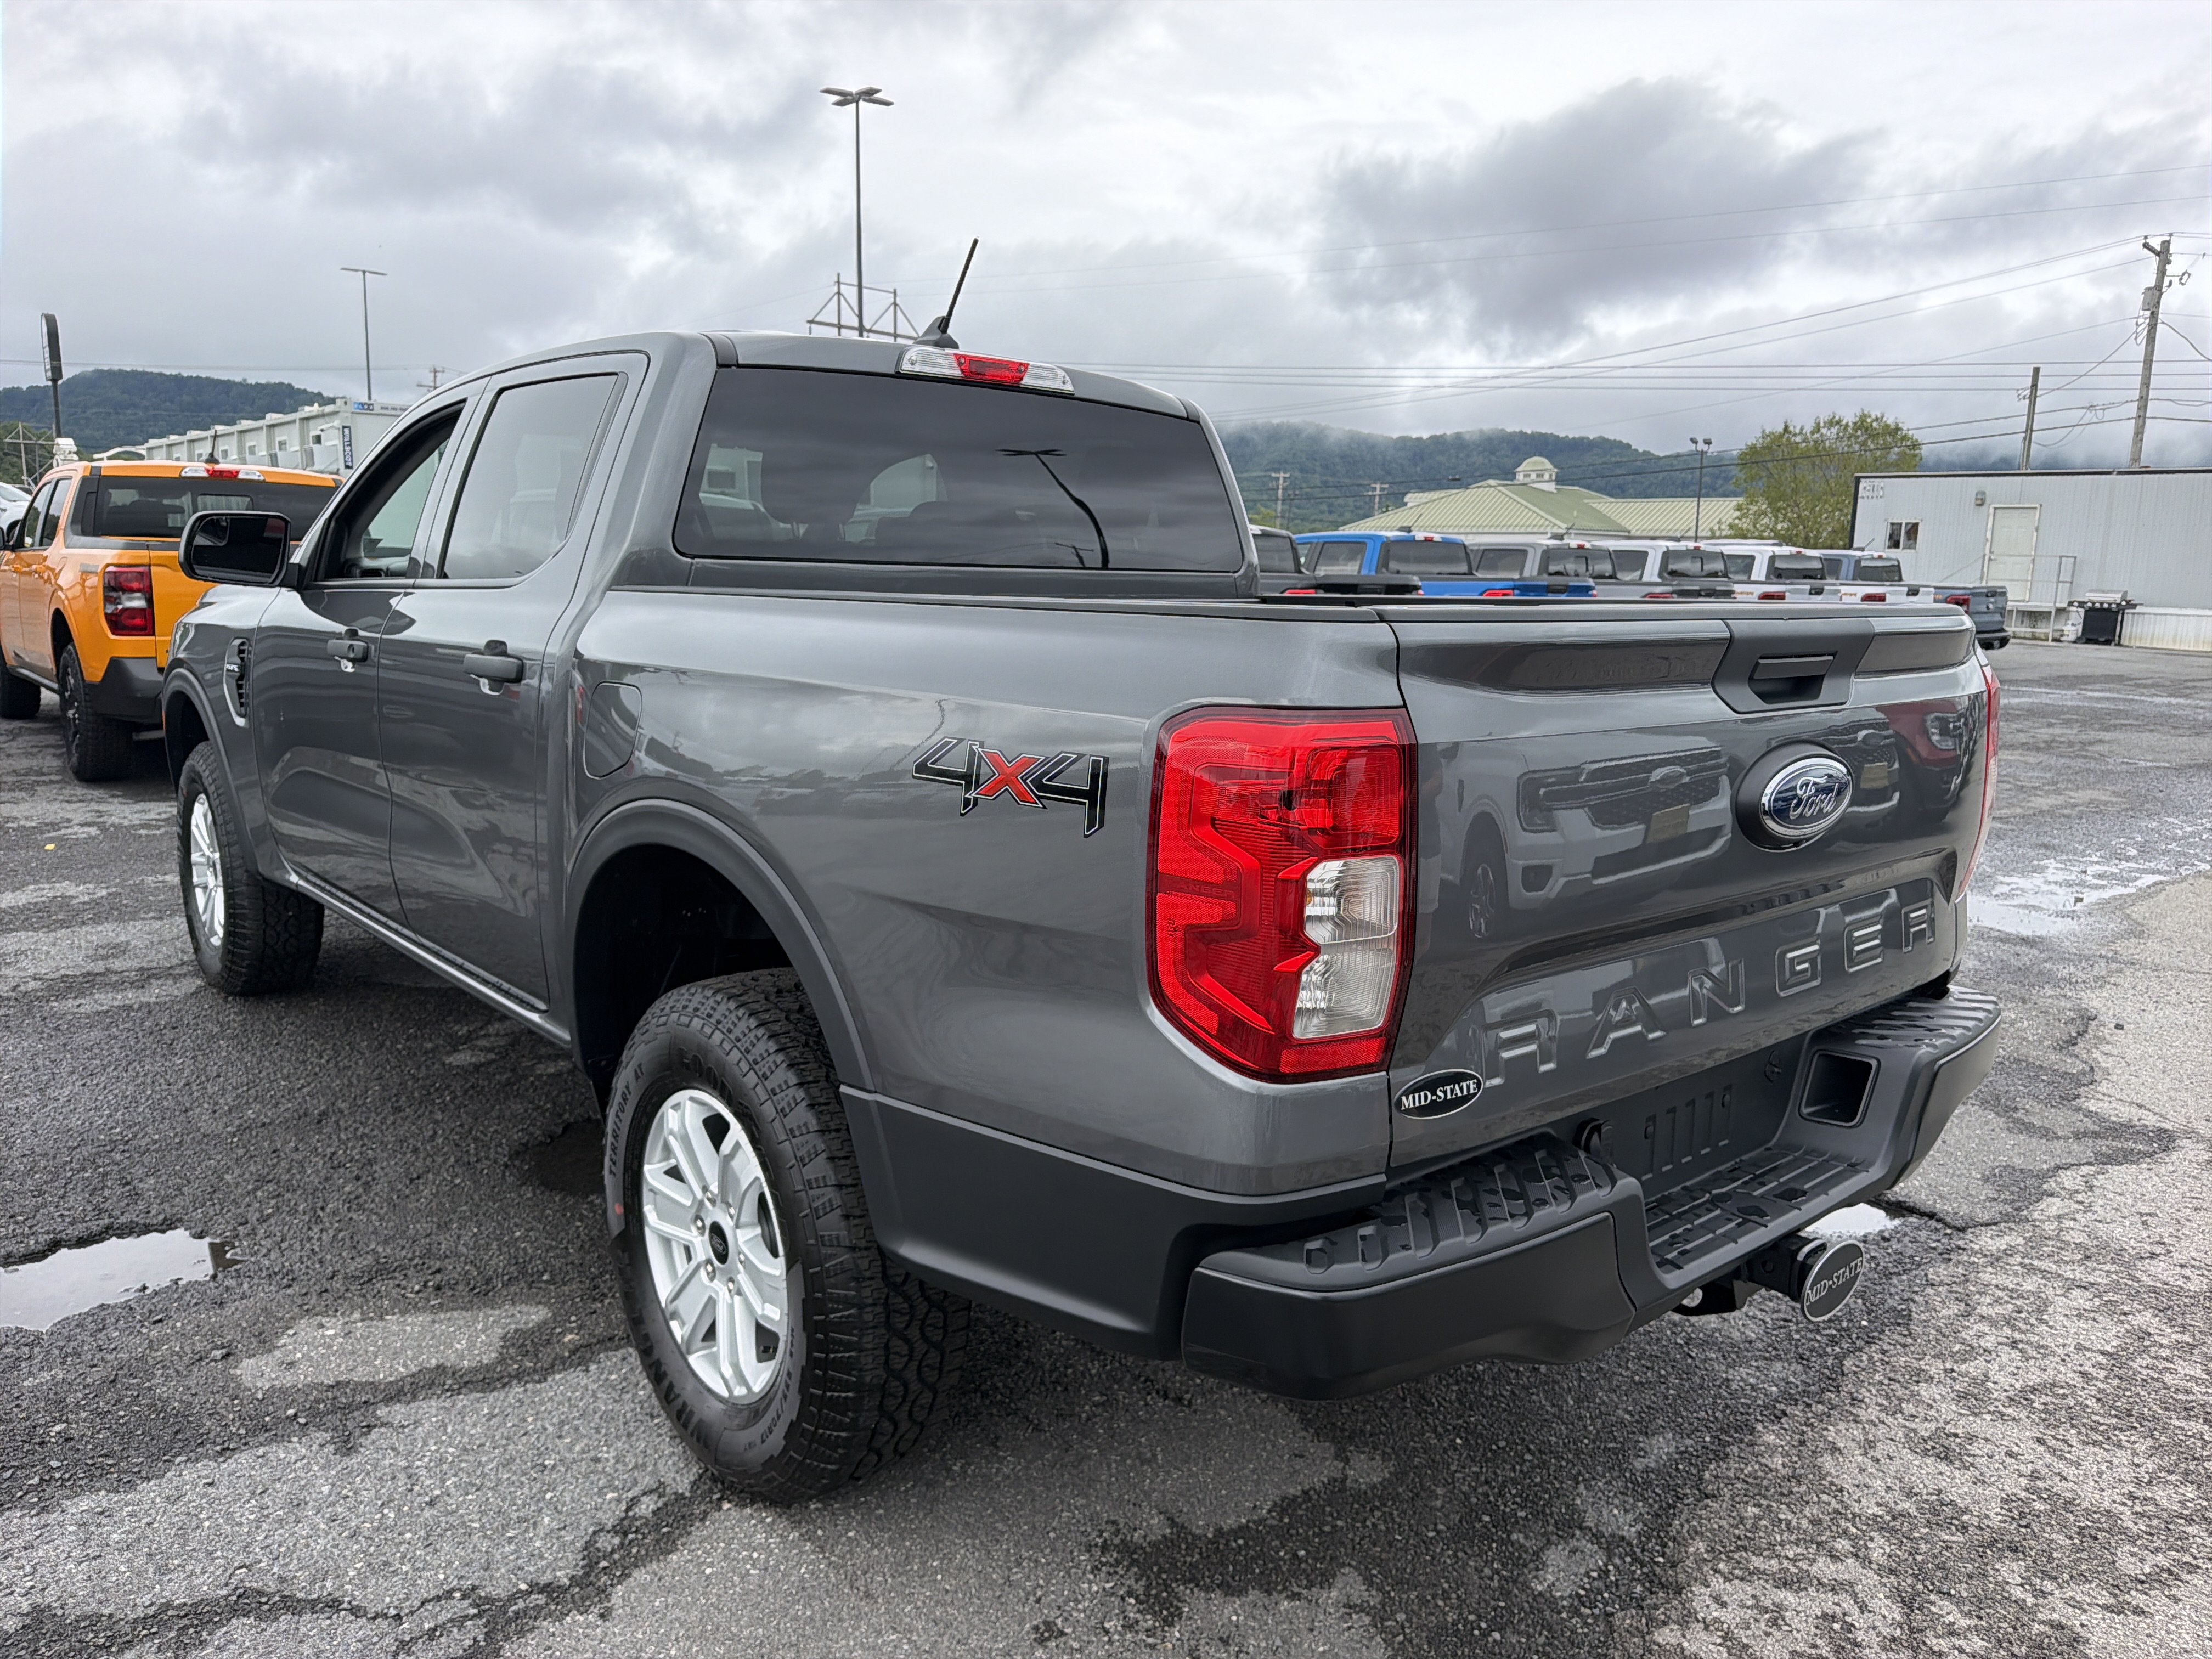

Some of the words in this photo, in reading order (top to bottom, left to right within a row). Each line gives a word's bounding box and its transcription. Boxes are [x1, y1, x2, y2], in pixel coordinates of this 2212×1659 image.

[1789, 776, 1839, 820] Ford
[1166, 878, 1235, 899] ANGER
[1481, 899, 1934, 1088] RANGER
[1401, 1079, 1478, 1110] MID-STATE
[609, 1081, 631, 1177] TERRITORY
[1805, 1257, 1863, 1306] MID-STATE
